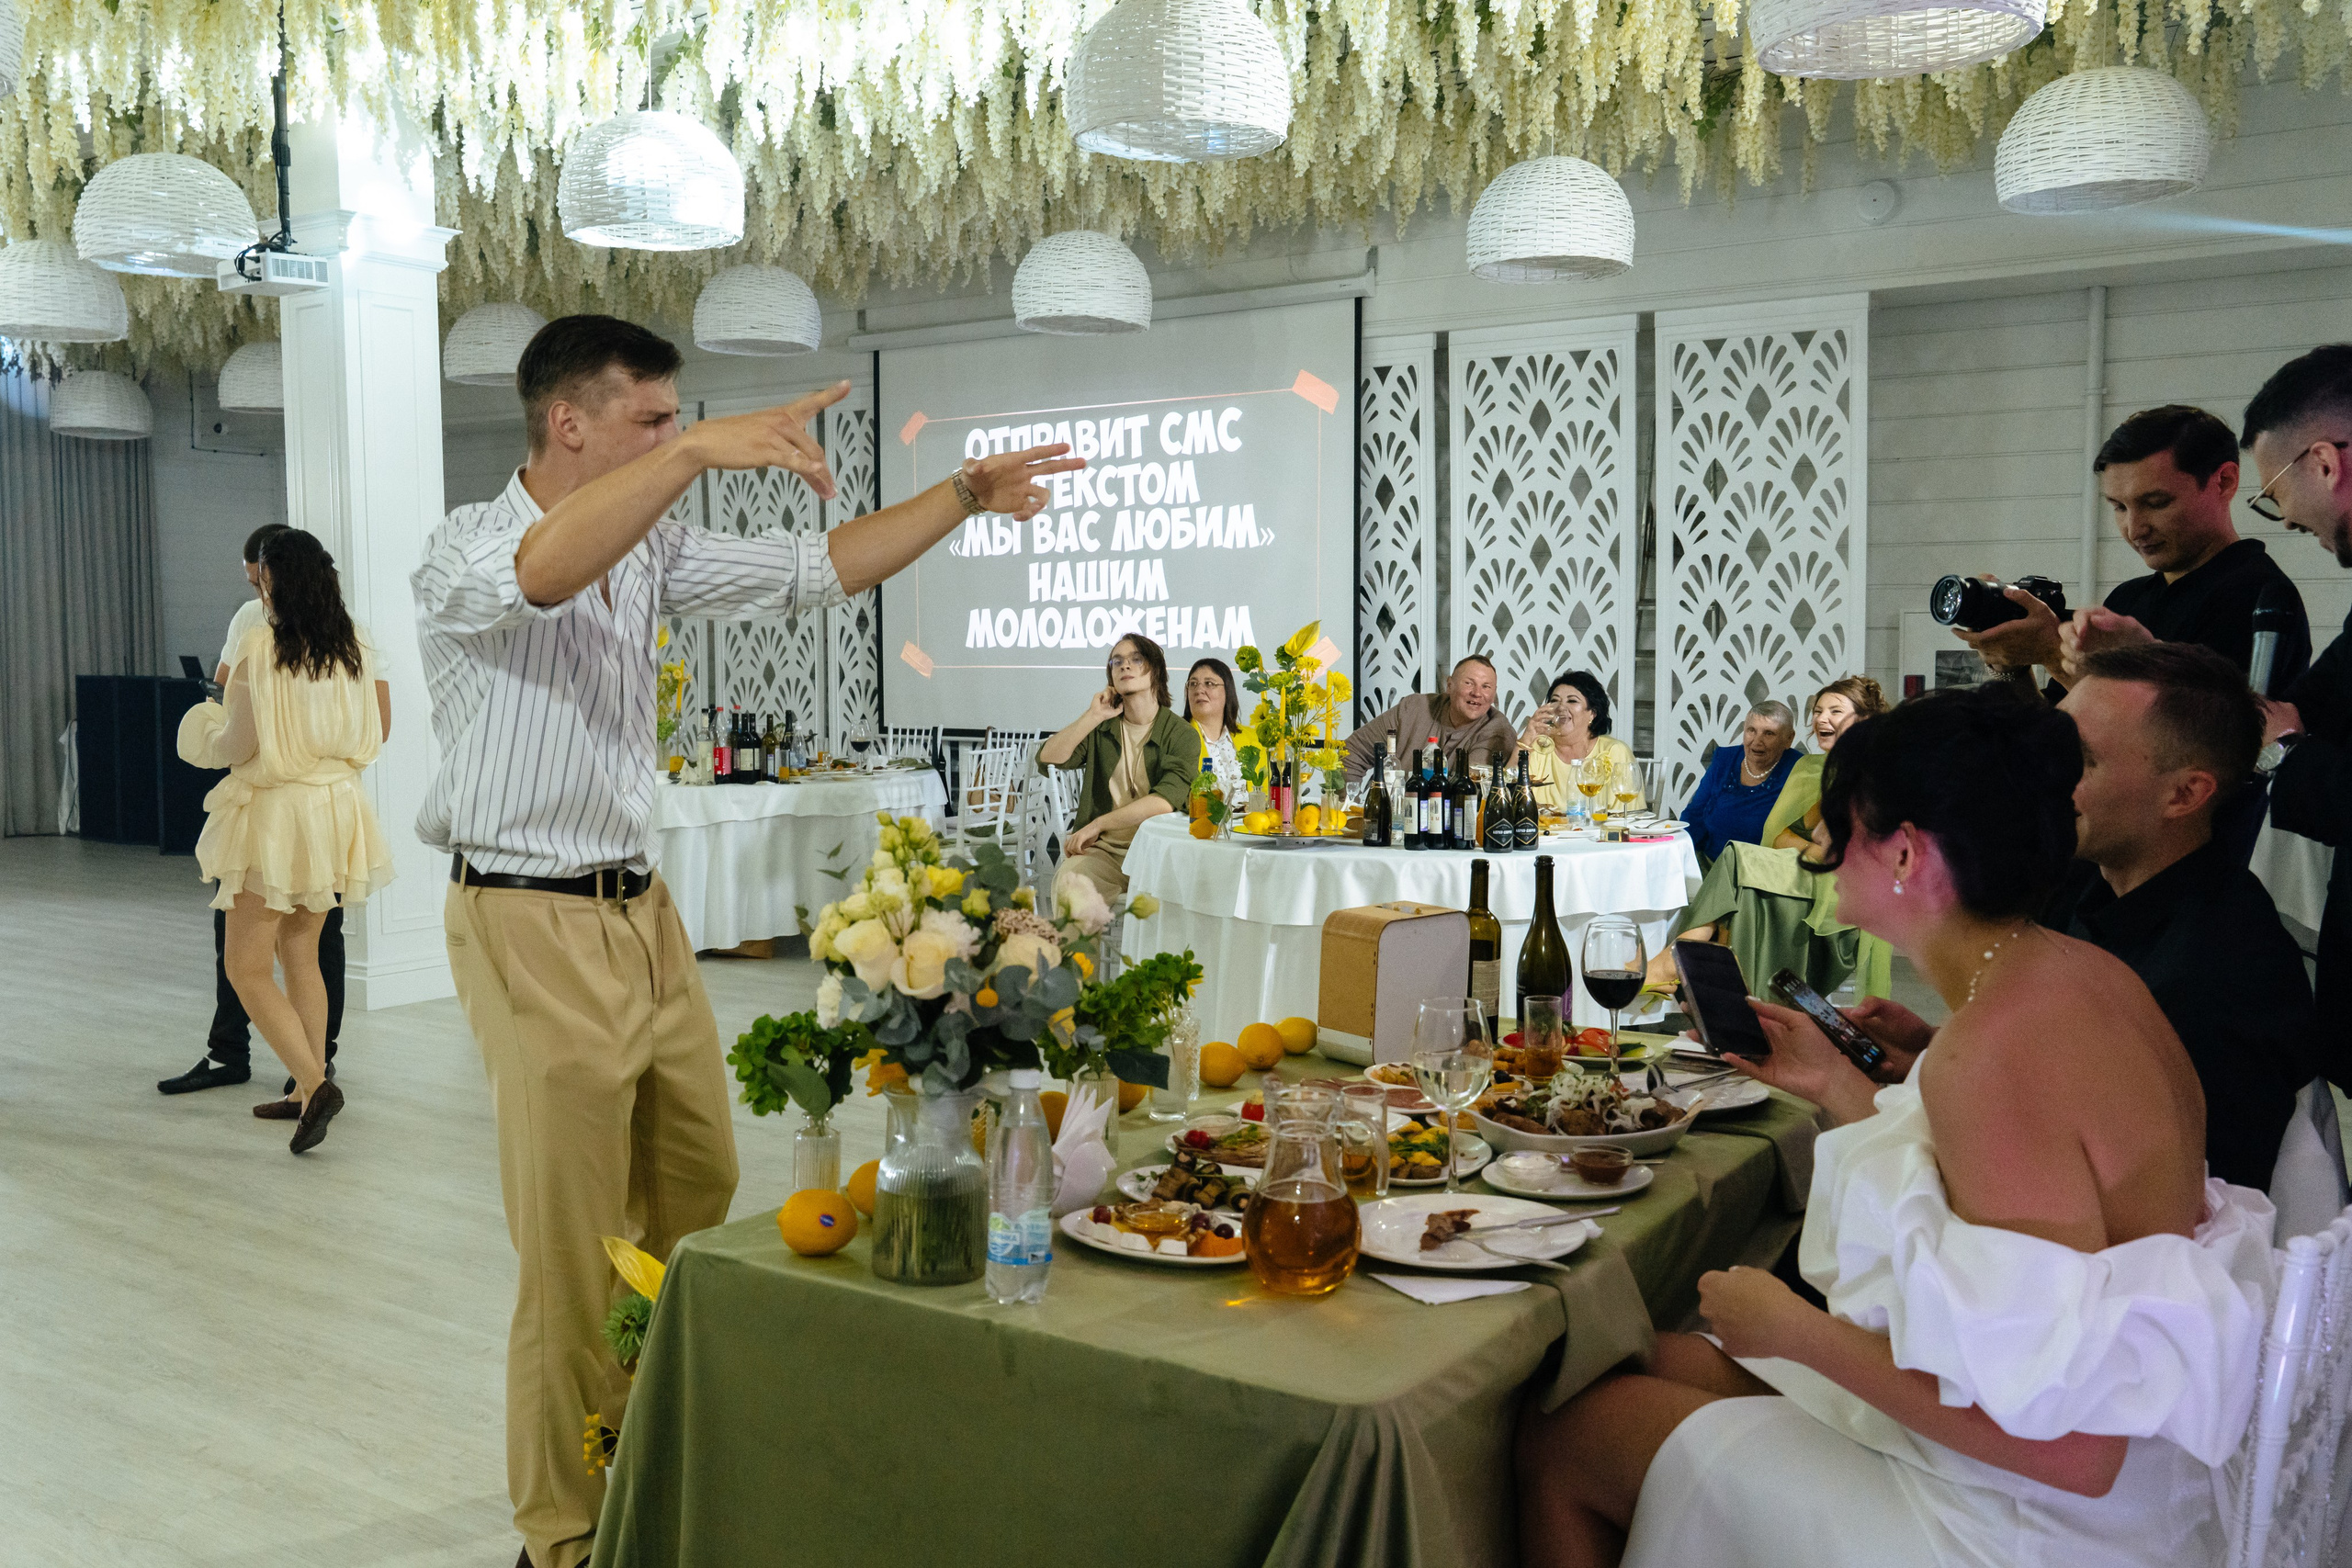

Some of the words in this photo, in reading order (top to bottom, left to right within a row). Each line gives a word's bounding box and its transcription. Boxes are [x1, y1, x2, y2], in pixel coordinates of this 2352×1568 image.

[965, 413, 1150, 461] ОТПРАВИТ
[1159, 406, 1243, 456] СМС
[1032, 511, 1102, 554] ВАС
[1110, 503, 1276, 552] ЛЮБИМ»
[1028, 558, 1170, 603] НАШИМ
[965, 604, 1257, 650] МОЛОДОЖЕНАМ
